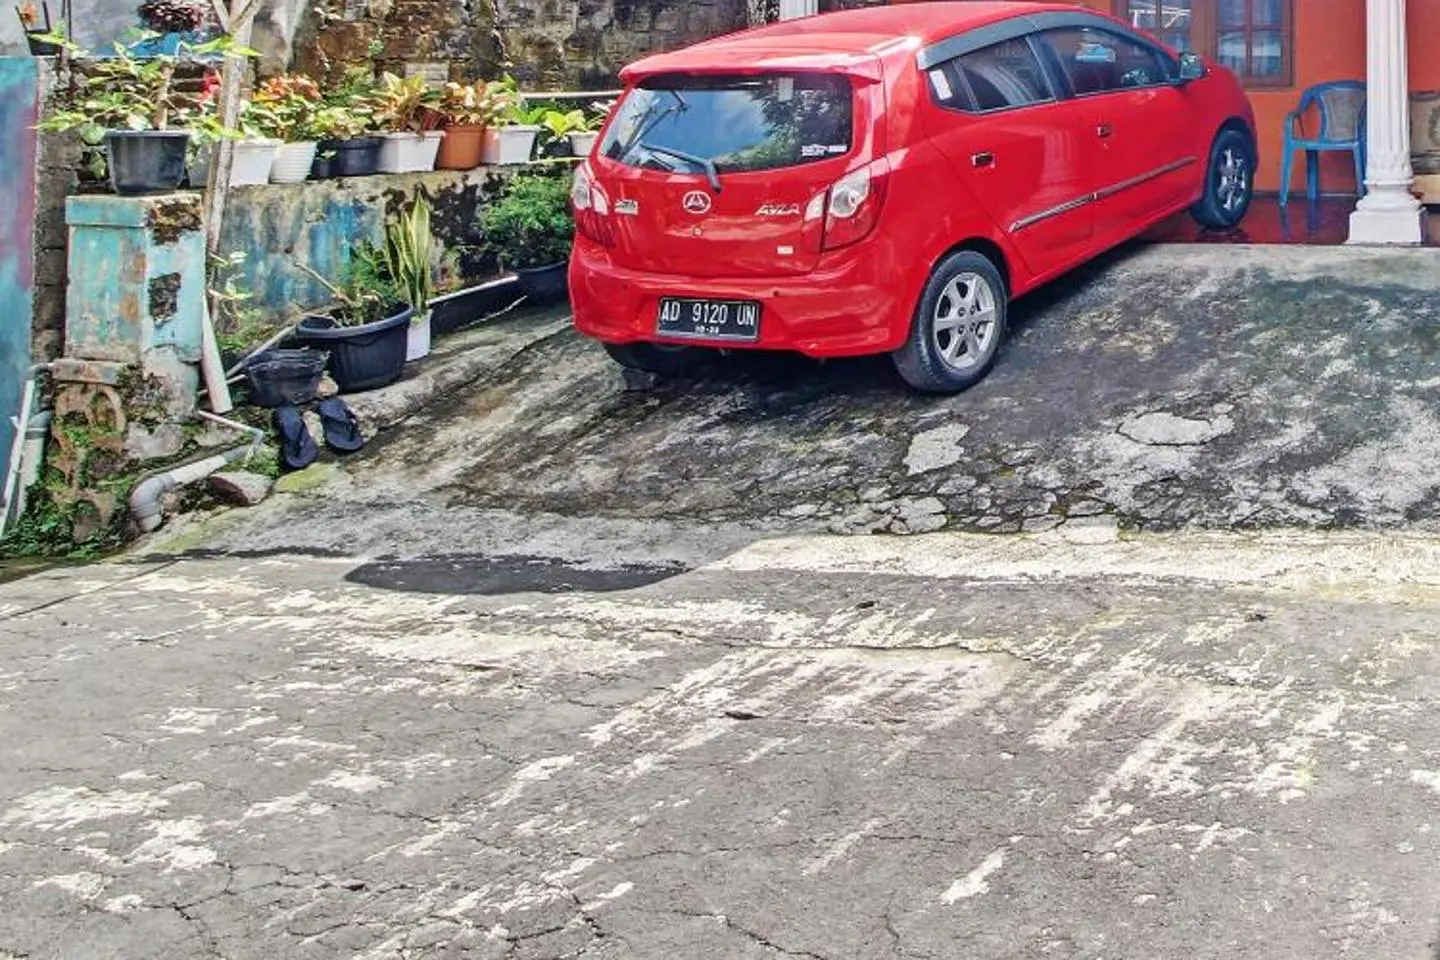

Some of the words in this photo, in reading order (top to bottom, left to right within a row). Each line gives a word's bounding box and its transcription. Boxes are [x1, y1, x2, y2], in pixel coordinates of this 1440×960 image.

[661, 300, 681, 322] AD
[692, 302, 729, 324] 9120
[736, 305, 756, 326] UN
